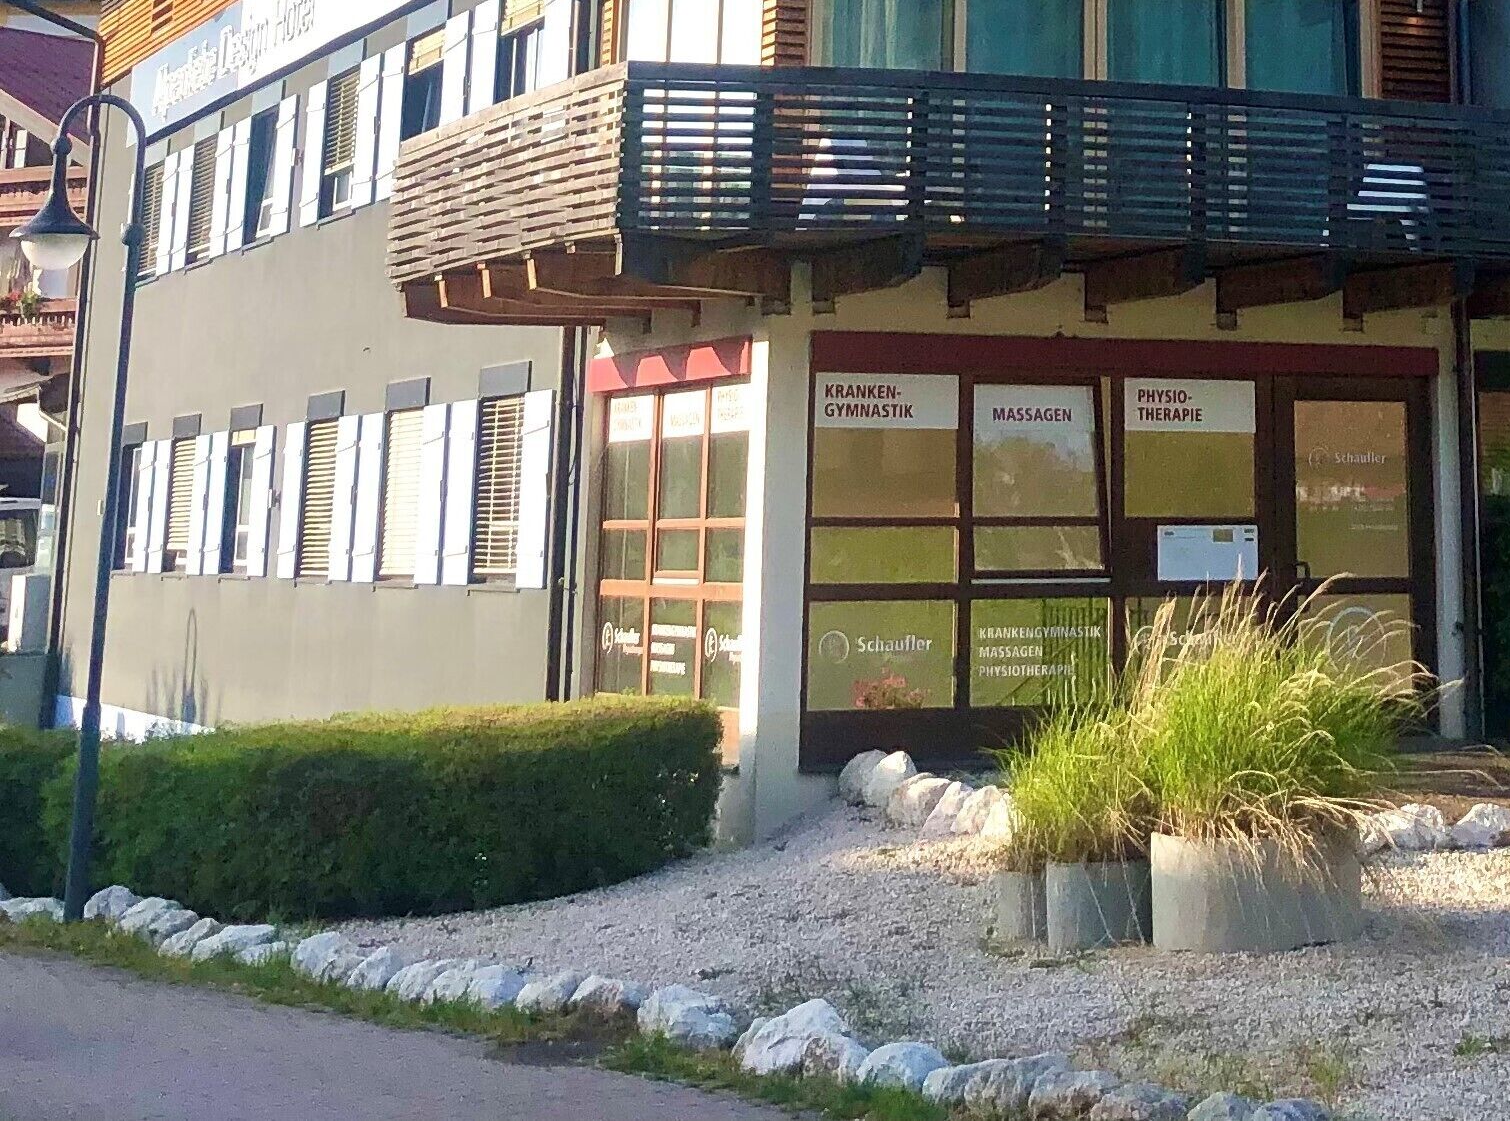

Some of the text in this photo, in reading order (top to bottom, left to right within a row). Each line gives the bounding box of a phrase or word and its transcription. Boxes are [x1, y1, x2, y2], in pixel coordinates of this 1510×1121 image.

[824, 383, 902, 400] KRANKEN-
[1136, 388, 1193, 405] PHYSIO-
[823, 401, 914, 420] GYMNASTIK
[991, 406, 1073, 423] MASSAGEN
[1136, 405, 1203, 423] THERAPIE
[1334, 451, 1387, 465] Schaufler
[978, 625, 1102, 639] KRANKENGYMNASTIK
[856, 634, 933, 653] Schaufler
[978, 645, 1043, 658] MASSAGEN
